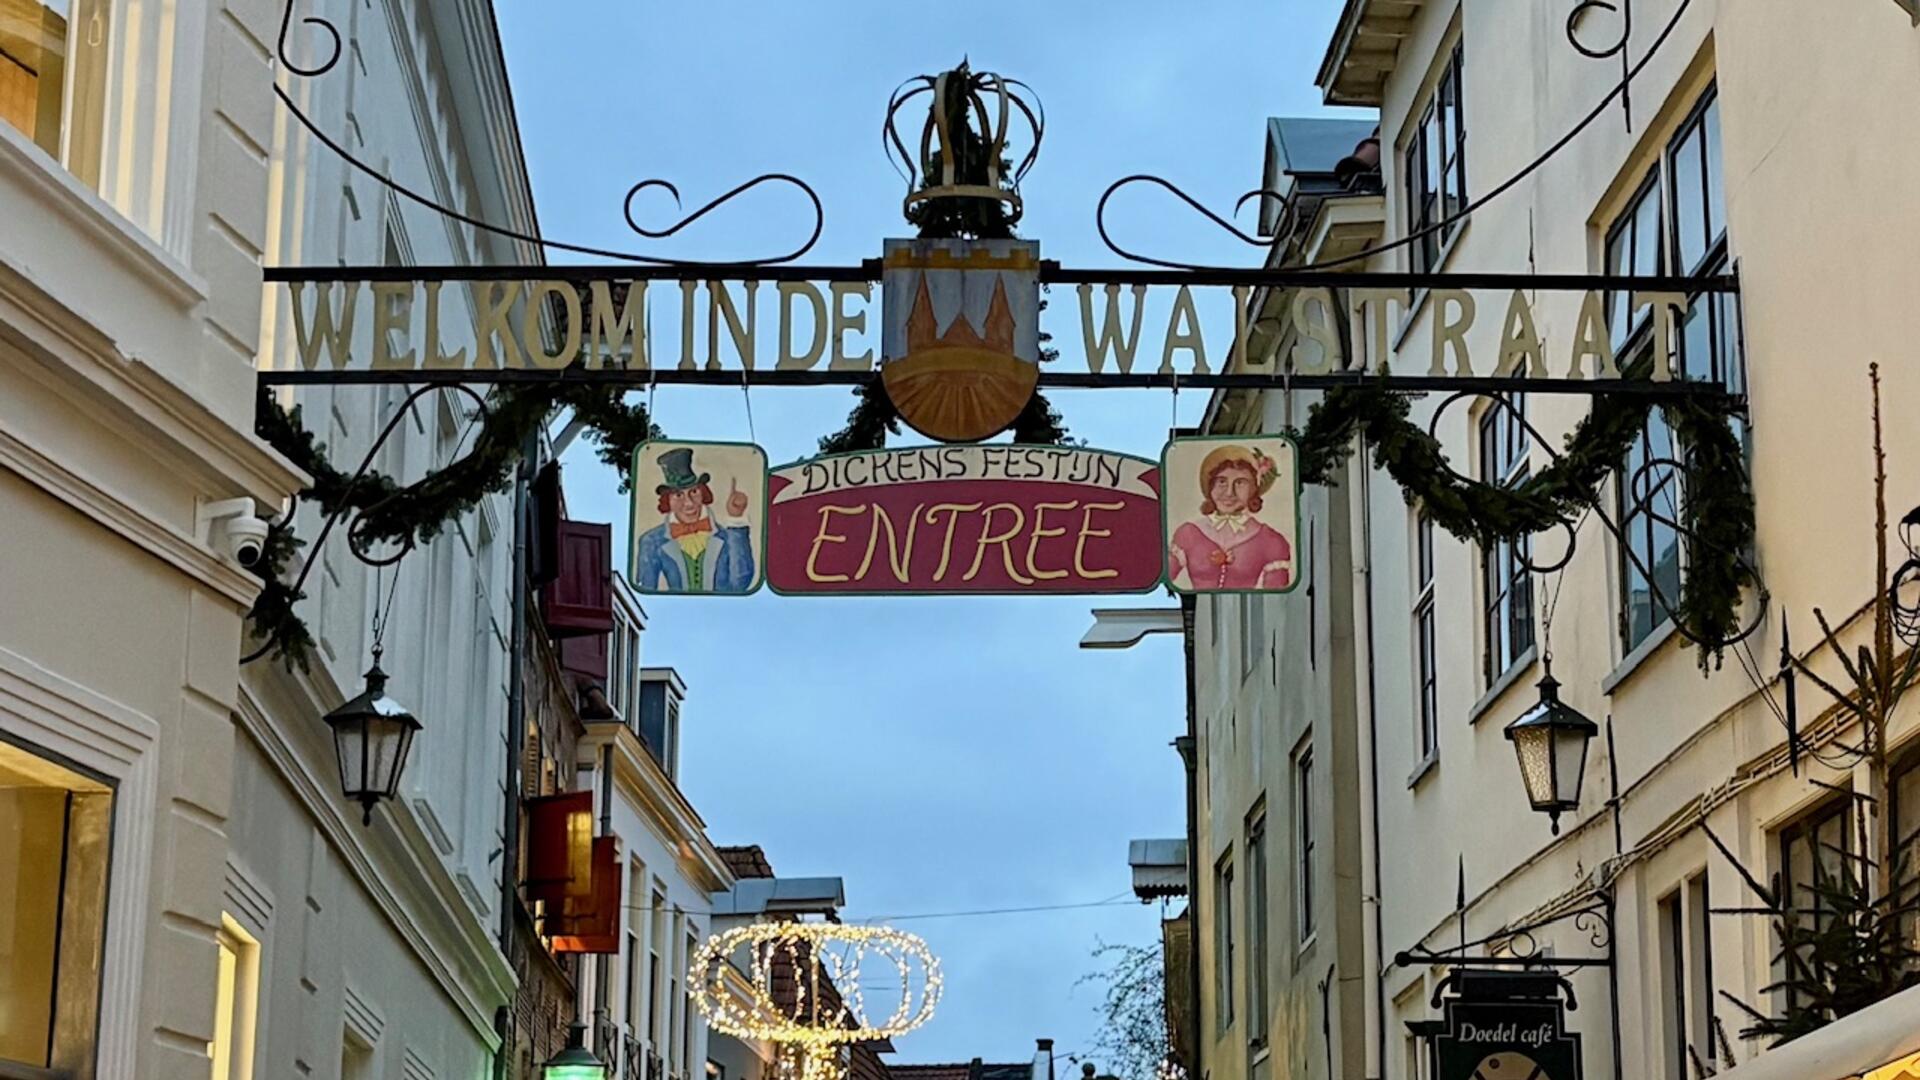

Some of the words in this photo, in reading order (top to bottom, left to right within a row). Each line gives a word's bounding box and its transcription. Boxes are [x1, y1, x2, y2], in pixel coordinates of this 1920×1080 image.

[289, 279, 651, 372] WELKOM
[679, 279, 757, 372] IN
[775, 279, 875, 372] DE
[1076, 283, 1688, 383] WALSTRAAT
[801, 449, 968, 495] DICKENS
[805, 501, 1126, 585] ENTREE
[1459, 1022, 1517, 1042] Doedel
[1520, 1023, 1553, 1048] café
